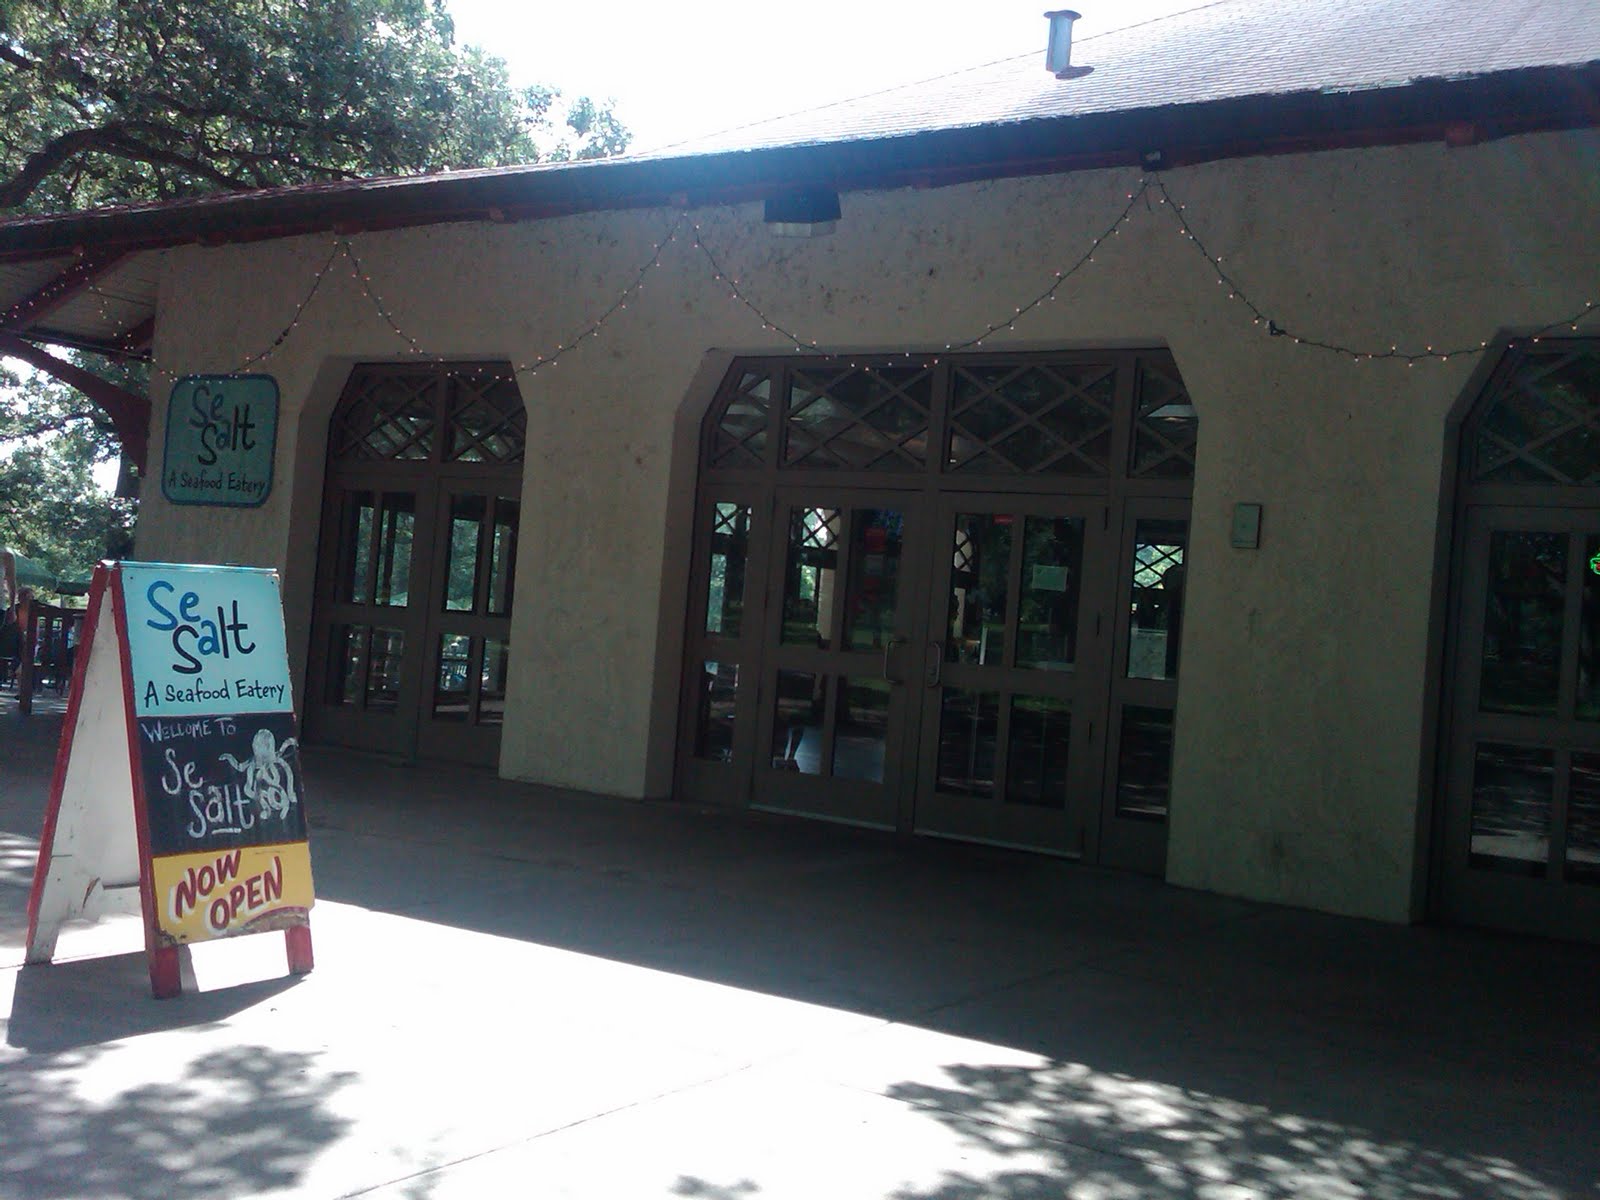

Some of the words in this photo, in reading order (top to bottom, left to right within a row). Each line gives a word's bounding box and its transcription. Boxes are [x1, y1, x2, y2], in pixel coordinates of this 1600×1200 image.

[189, 385, 224, 428] Se
[198, 403, 256, 466] Salt
[168, 470, 177, 488] A
[180, 469, 223, 491] Seafood
[227, 472, 266, 498] Eatery
[146, 580, 201, 631] Se
[172, 600, 256, 674] Salt
[144, 681, 159, 708] A
[165, 678, 230, 702] Seafood
[235, 679, 285, 703] Eatery
[161, 748, 203, 795] Se
[187, 784, 254, 838] Salt
[175, 850, 241, 919] NOW
[209, 856, 283, 930] OPEN
